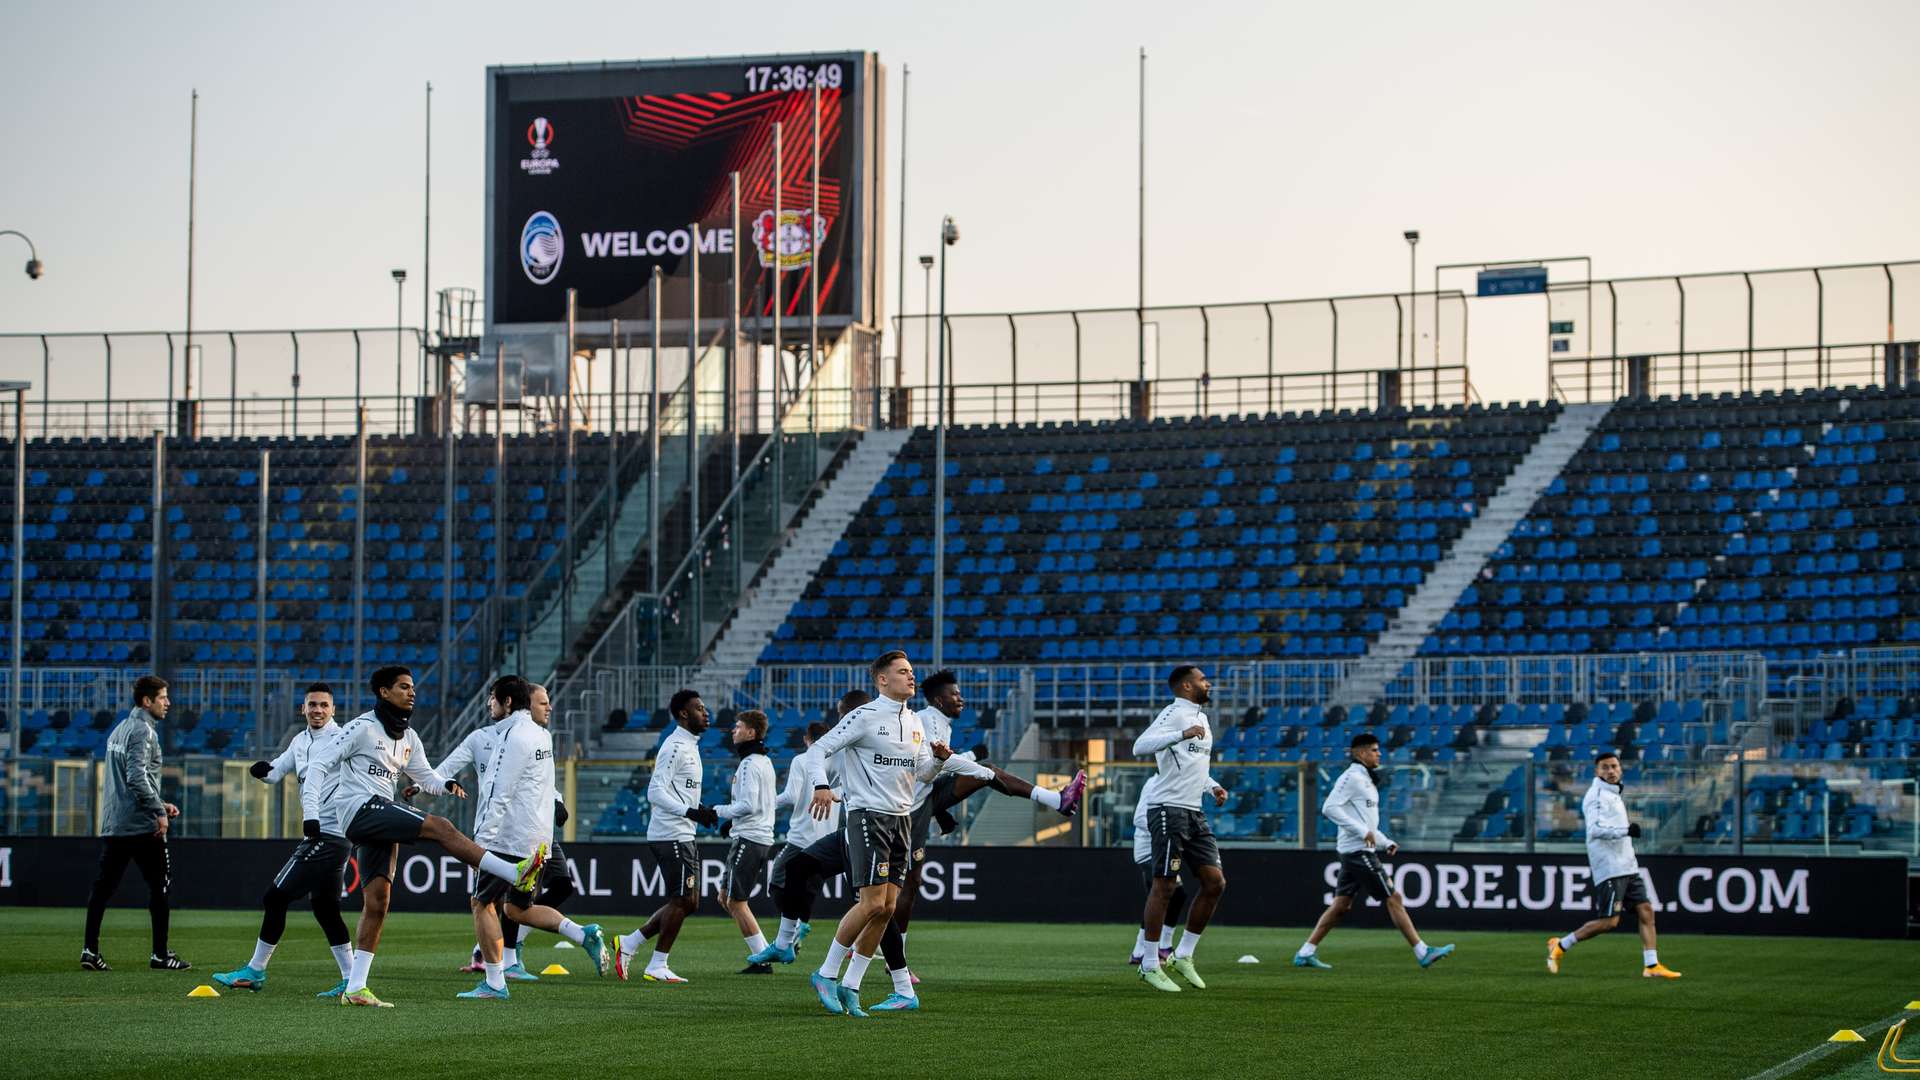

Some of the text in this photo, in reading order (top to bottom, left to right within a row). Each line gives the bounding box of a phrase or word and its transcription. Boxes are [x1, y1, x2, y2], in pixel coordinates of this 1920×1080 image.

[744, 64, 843, 92] 17:36:49
[580, 229, 734, 258] WELCOME
[403, 854, 612, 896] OFAL
